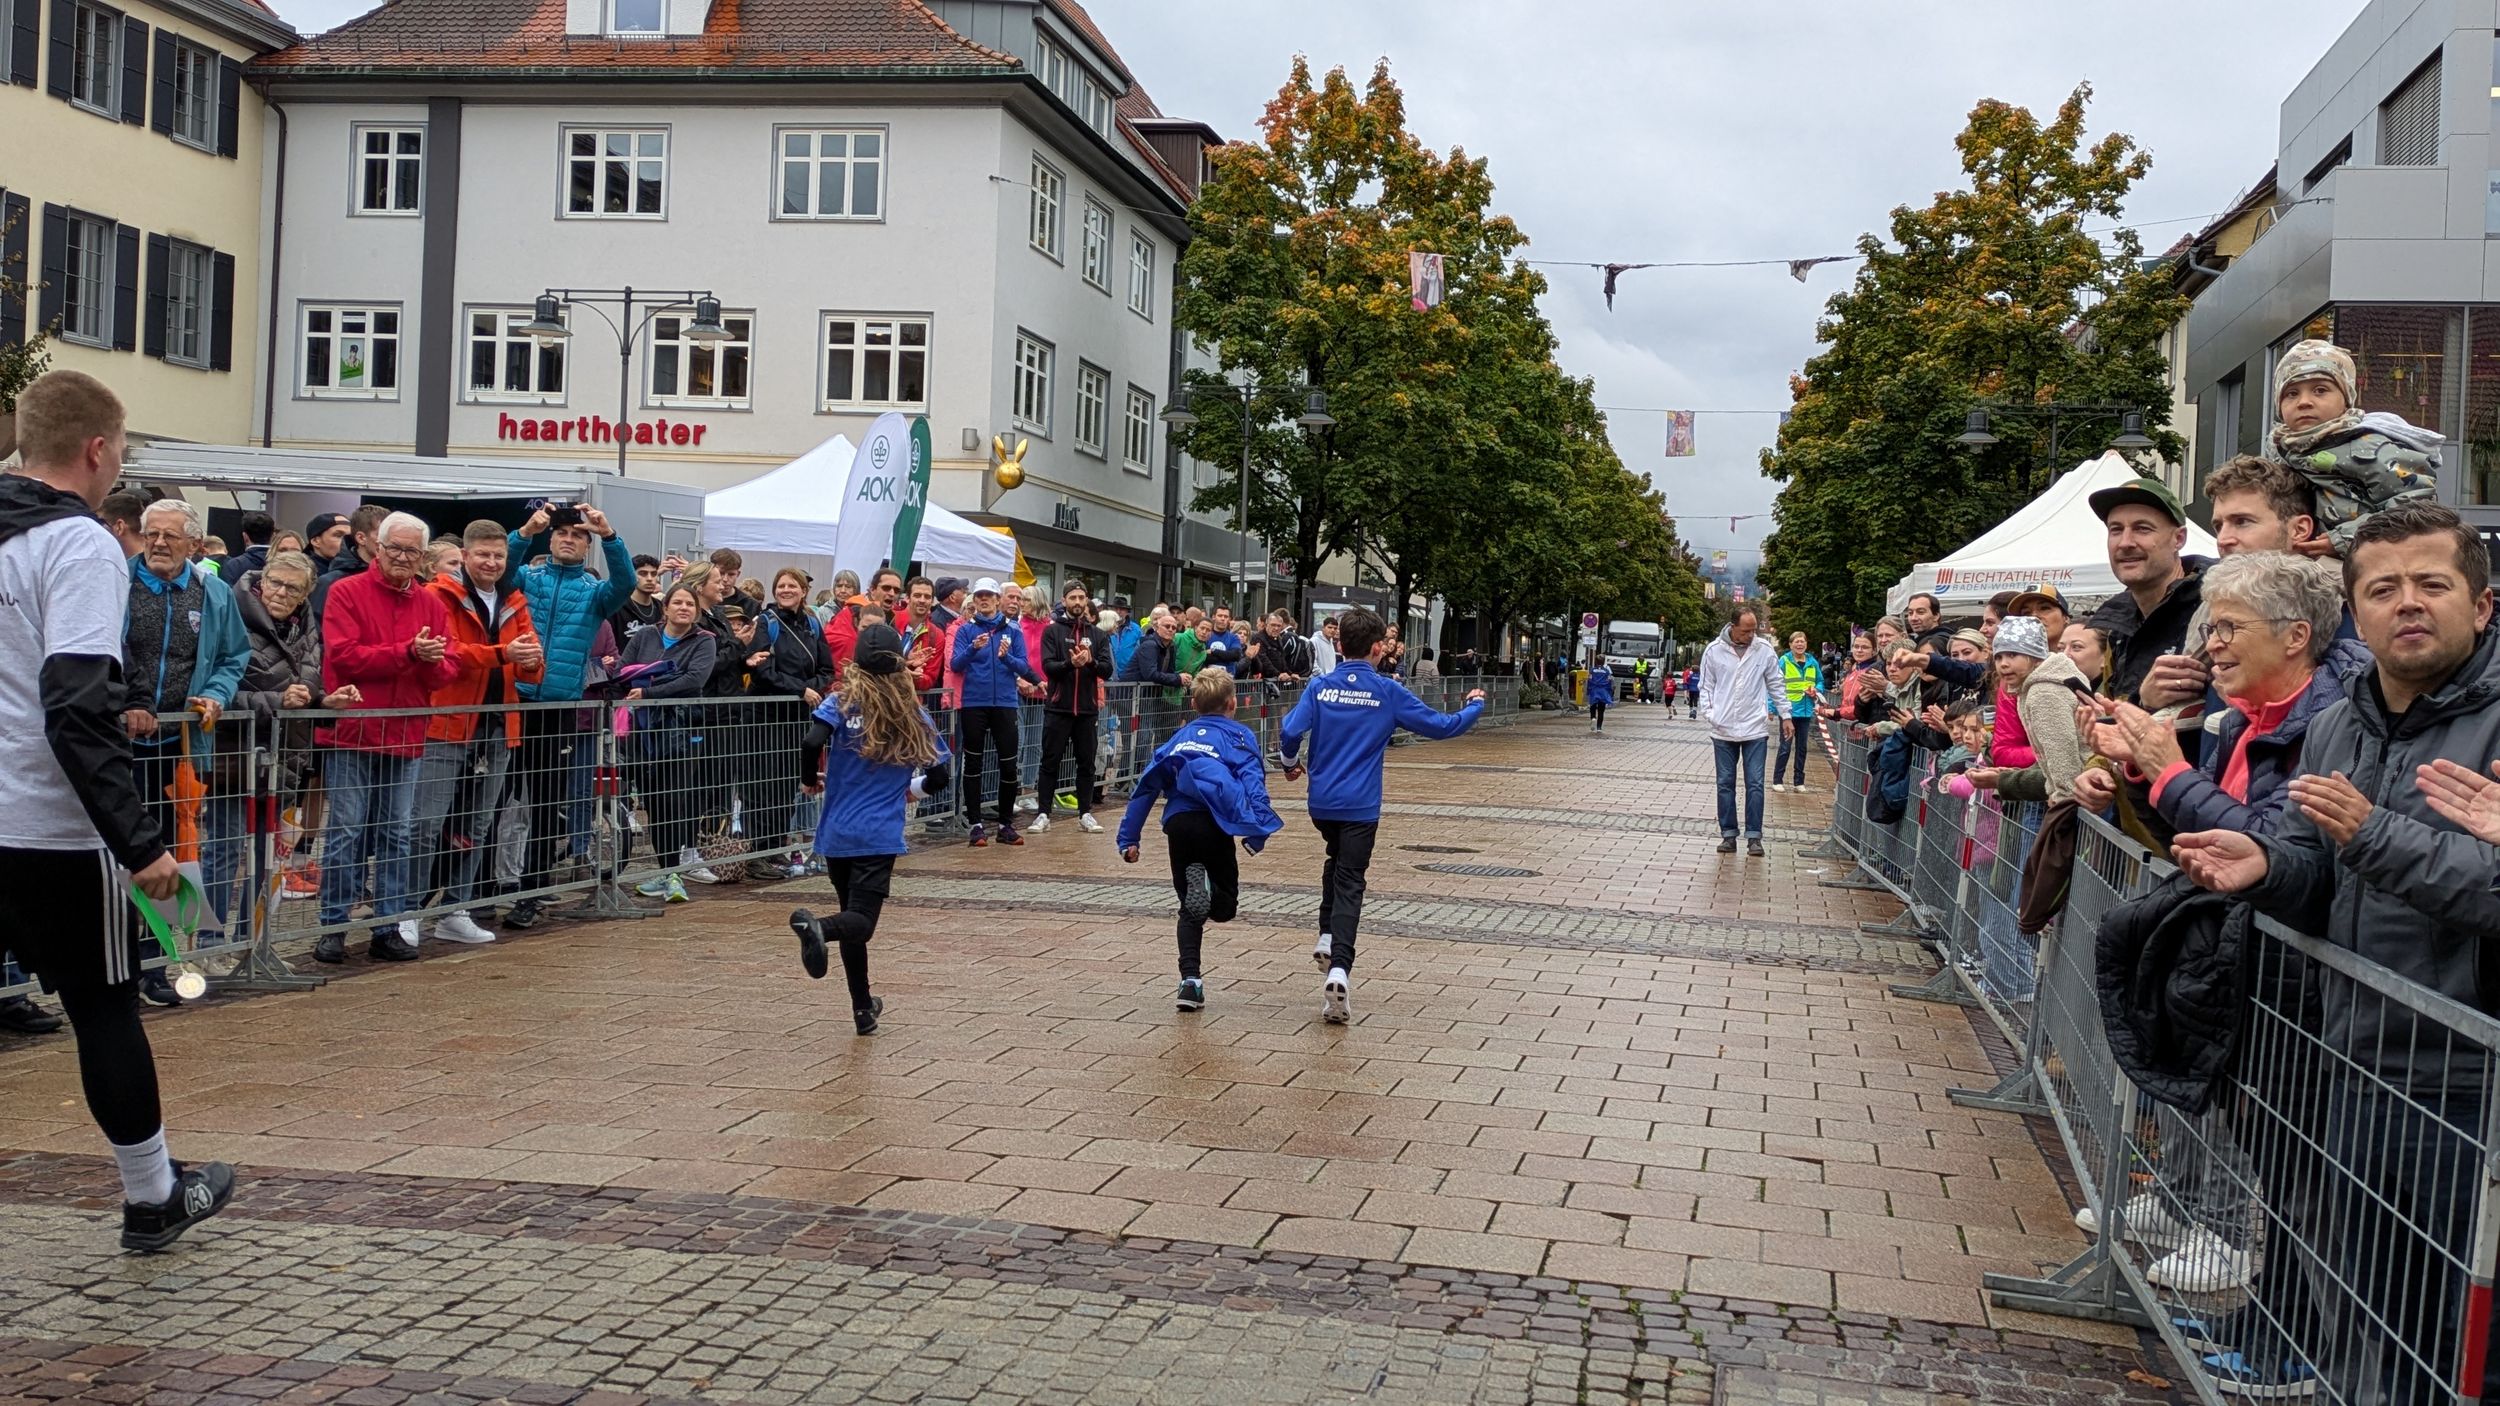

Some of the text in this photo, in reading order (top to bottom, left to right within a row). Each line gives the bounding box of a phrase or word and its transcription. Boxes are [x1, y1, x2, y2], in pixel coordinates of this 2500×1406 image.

[498, 412, 706, 446] haartheater
[856, 476, 896, 502] AOK
[1954, 568, 2074, 584] LEICHTATHLETIK
[1317, 688, 1339, 702] JSG
[1340, 689, 1372, 699] BALINGEN
[1338, 697, 1380, 707] WEILSTETTEN
[845, 715, 864, 729] JS
